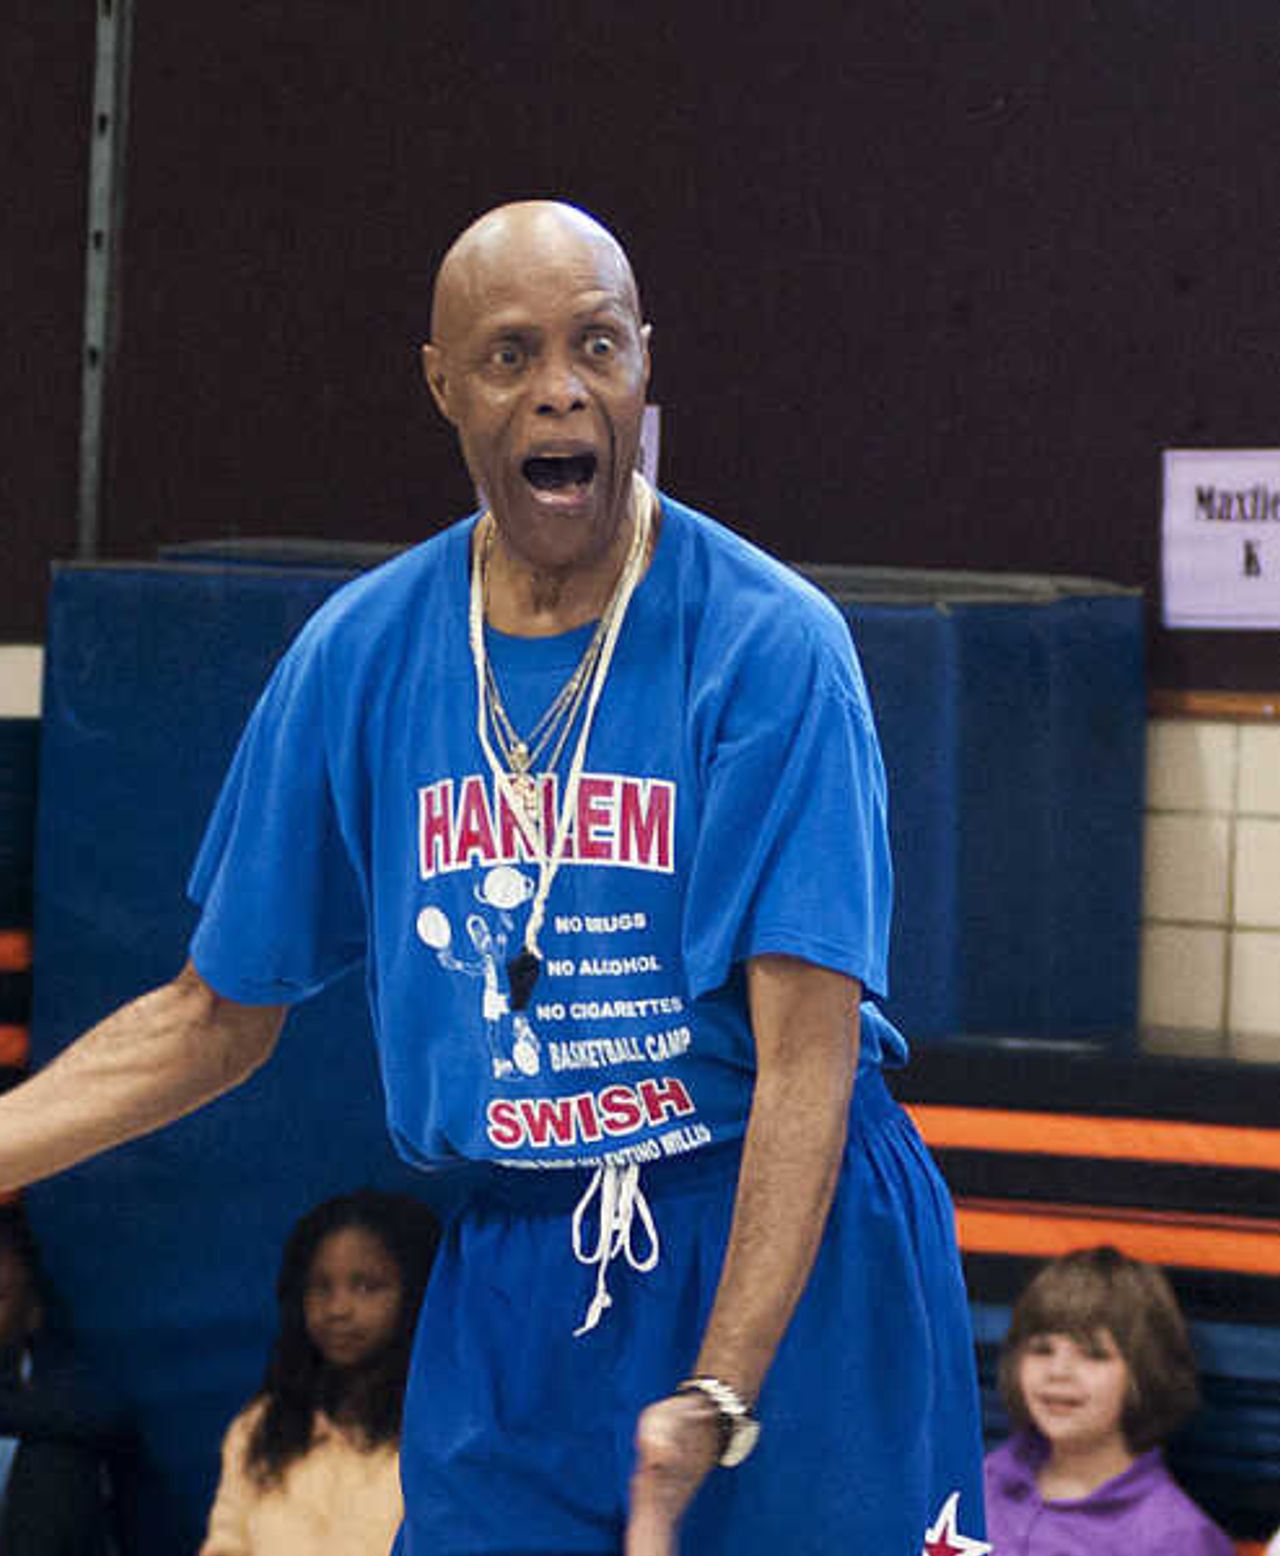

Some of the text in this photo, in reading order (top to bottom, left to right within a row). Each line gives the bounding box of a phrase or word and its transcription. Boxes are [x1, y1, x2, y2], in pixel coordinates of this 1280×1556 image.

[1243, 540, 1261, 576] K
[554, 912, 647, 934] NO DRUGS
[547, 955, 662, 977] NO ALCOHOL
[536, 997, 684, 1021] NO CIGARETTES
[548, 1026, 691, 1072] BASKETBALL CAMP
[487, 1076, 697, 1149] SWISH
[659, 1123, 712, 1156] WILLIS
